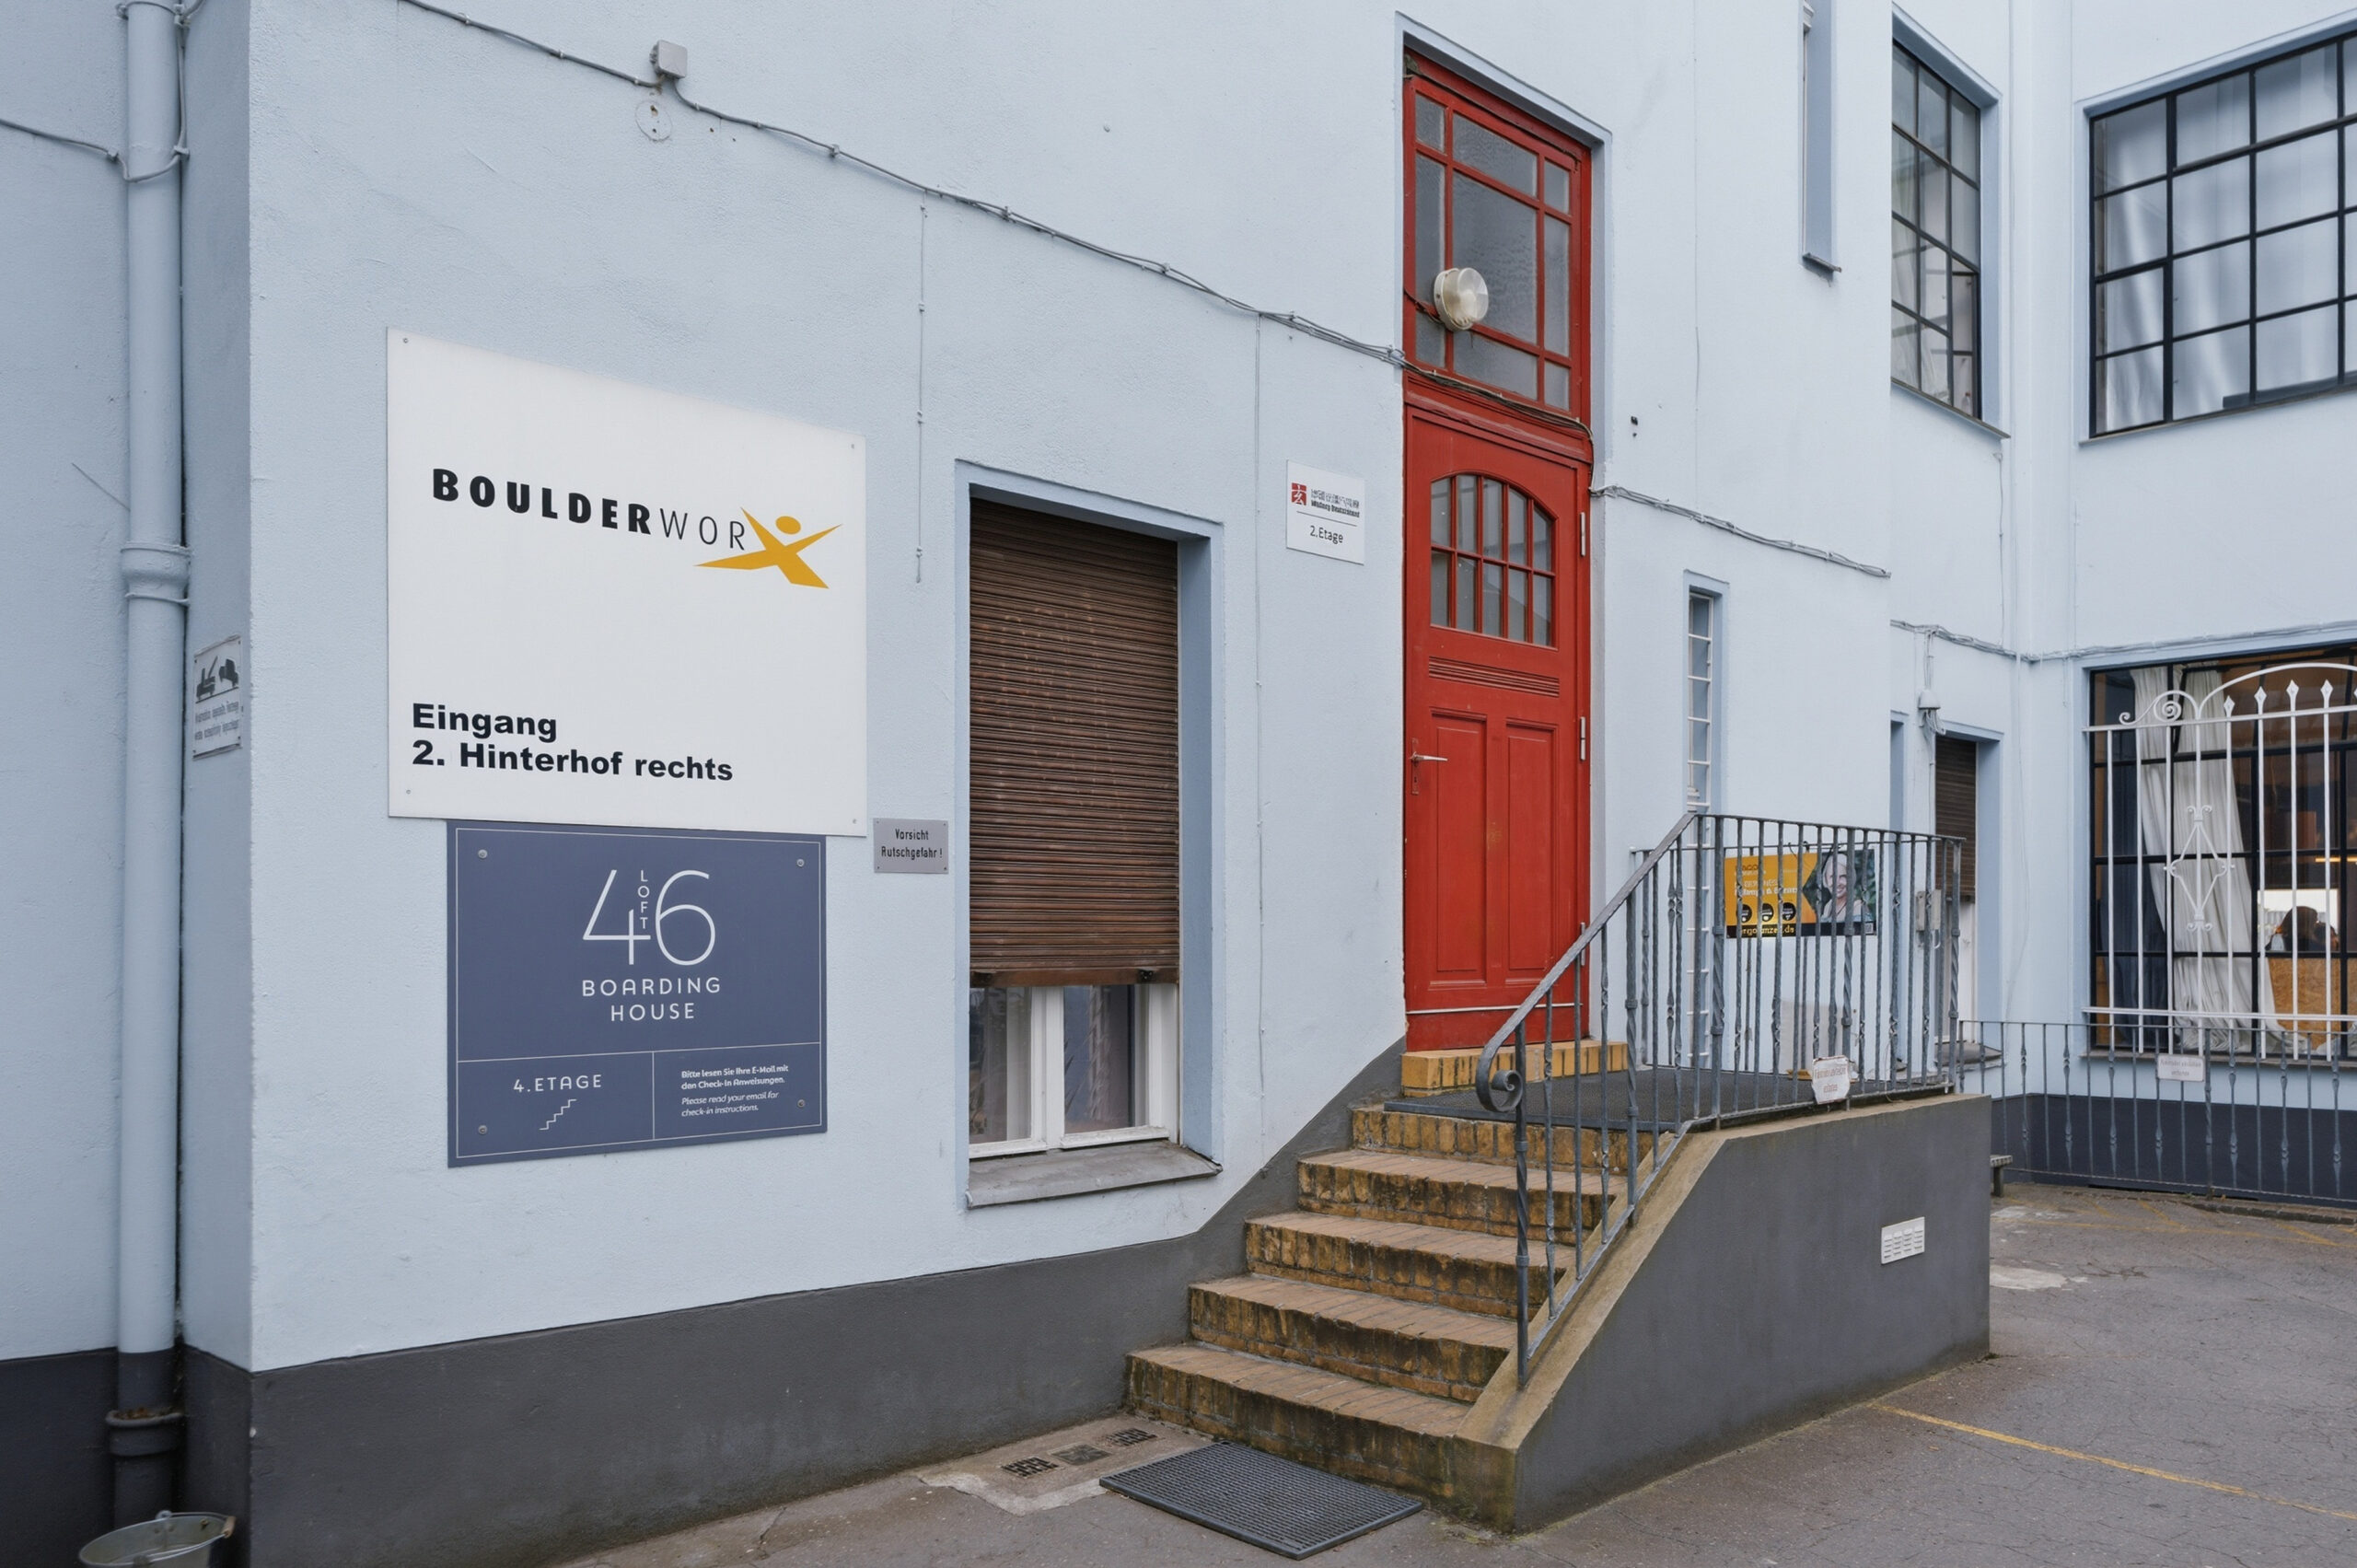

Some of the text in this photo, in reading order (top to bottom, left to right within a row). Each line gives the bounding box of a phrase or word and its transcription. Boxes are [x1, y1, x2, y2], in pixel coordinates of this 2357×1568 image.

[1309, 525, 1343, 544] 2.Etage
[412, 703, 557, 743] Eingang
[412, 739, 733, 781] 2. Hinterhof rechts
[895, 828, 929, 841] Vorsicht
[637, 869, 650, 930] LOFT
[583, 869, 716, 966] 46
[582, 977, 720, 997] BOARDING
[610, 1003, 695, 1022] HOUSE
[681, 1064, 789, 1079] Bitte lesen Sie Ihre E-Mail mit
[681, 1082, 697, 1090] den
[681, 1090, 780, 1105] Please read your email for
[681, 1107, 714, 1117] check-in
